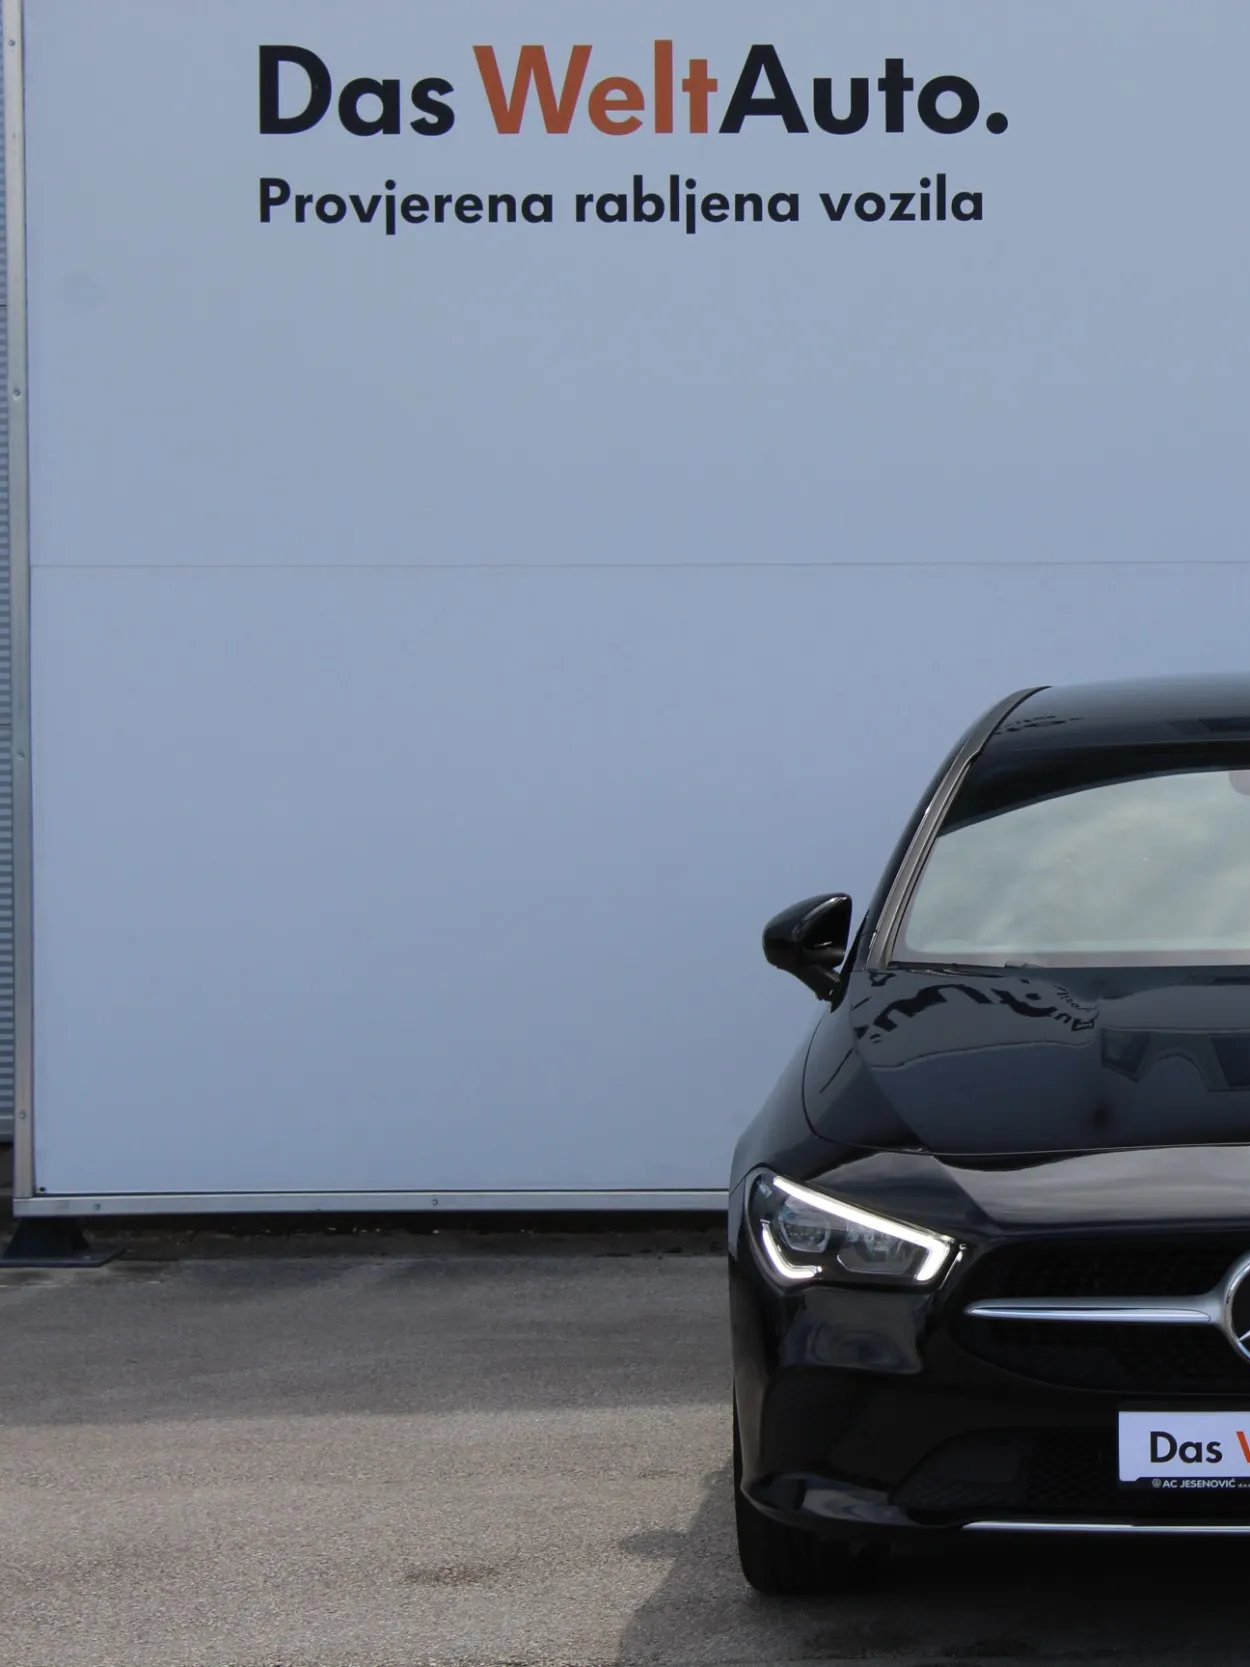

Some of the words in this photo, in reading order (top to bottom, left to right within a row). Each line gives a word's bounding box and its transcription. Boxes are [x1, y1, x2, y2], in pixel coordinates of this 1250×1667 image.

[259, 44, 455, 137] Das
[473, 39, 1009, 136] WeltAuto.
[259, 177, 553, 236] Provjerena
[575, 174, 800, 235] rabljena
[818, 173, 983, 223] vozila
[1149, 1430, 1223, 1464] Das
[1162, 1479, 1178, 1489] AC
[1179, 1477, 1236, 1489] JESENOVIĆ
